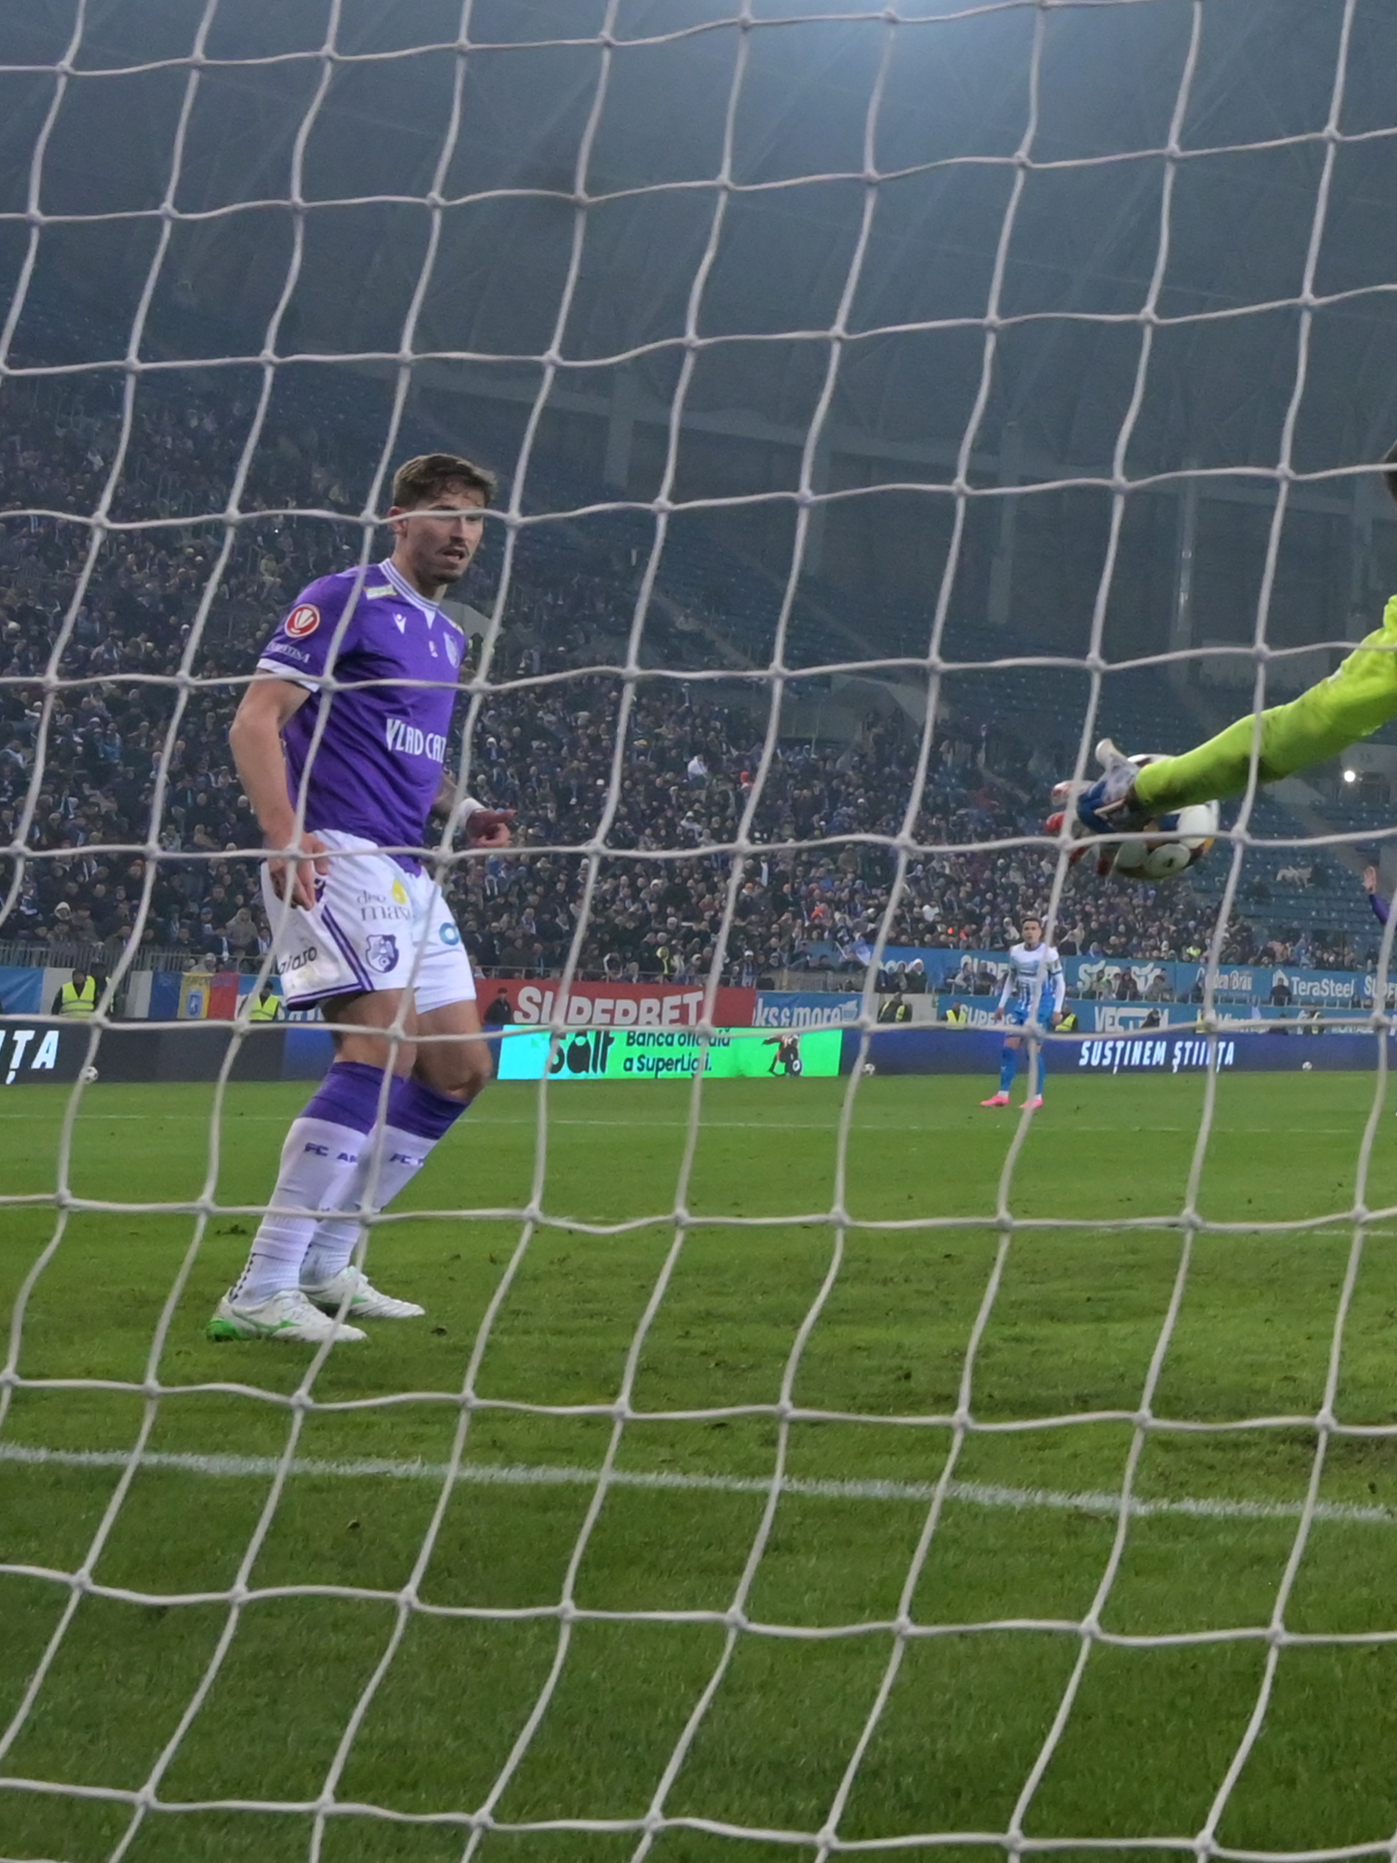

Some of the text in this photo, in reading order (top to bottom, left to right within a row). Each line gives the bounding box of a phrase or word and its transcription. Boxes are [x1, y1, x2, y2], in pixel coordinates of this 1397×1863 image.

[386, 718, 422, 756] VLAD
[1291, 976, 1355, 998] TeraSteel
[626, 1028, 731, 1047] Banca oficală
[0, 1030, 60, 1085] ȚA
[623, 1052, 713, 1079] a SuperLigi.
[1079, 1041, 1167, 1074] SUSȚINEM
[303, 1142, 329, 1157] FC
[389, 1153, 412, 1165] FC
